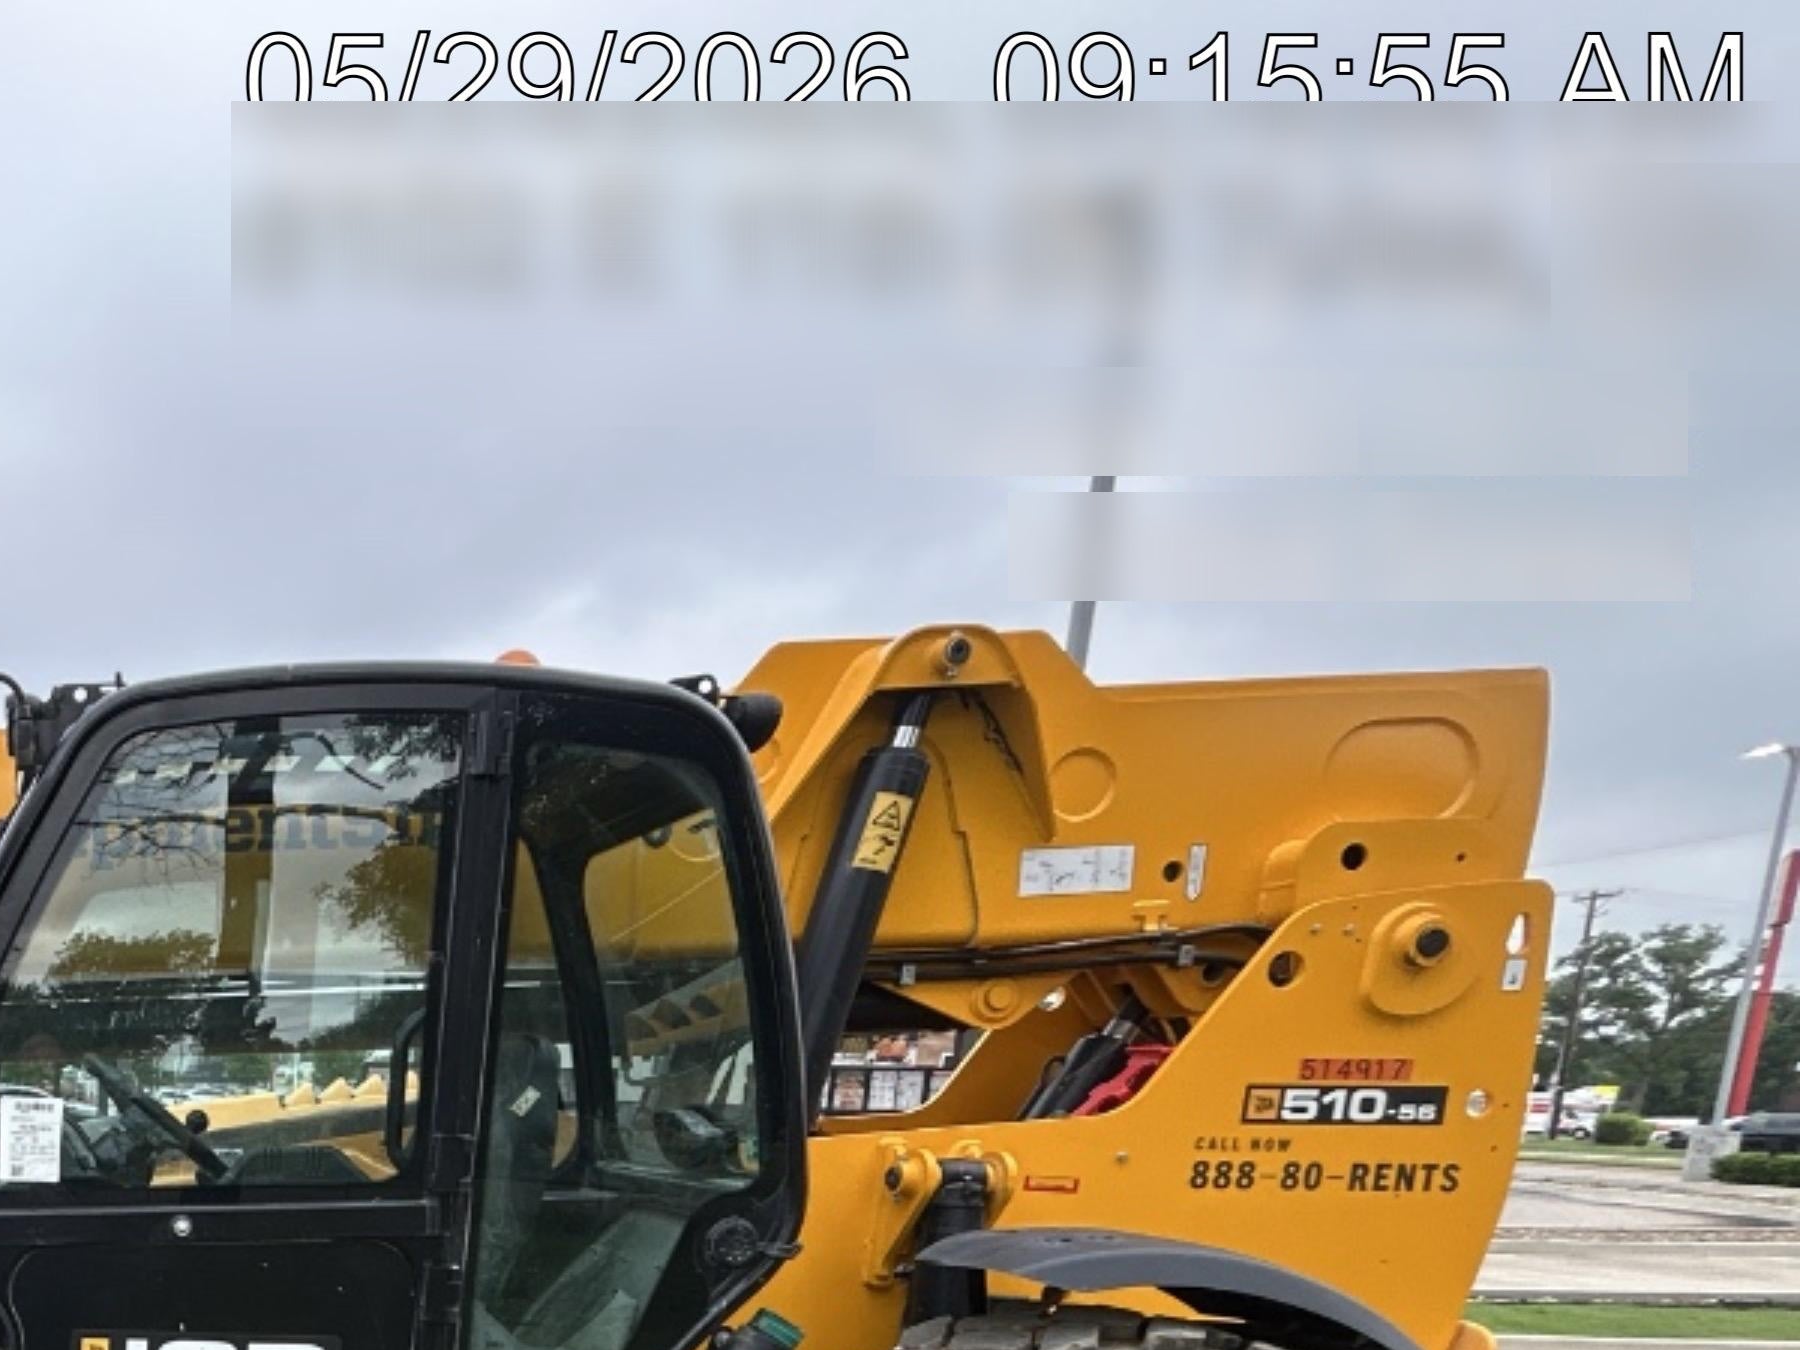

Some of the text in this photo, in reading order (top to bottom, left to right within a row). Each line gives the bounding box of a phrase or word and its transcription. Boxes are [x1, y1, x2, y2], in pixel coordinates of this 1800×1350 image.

[1301, 1058, 1408, 1080] 514917
[1280, 1087, 1439, 1122] 510-56
[1193, 1136, 1292, 1152] CALL NOW
[1189, 1160, 1462, 1193] 888-80-RENTS
